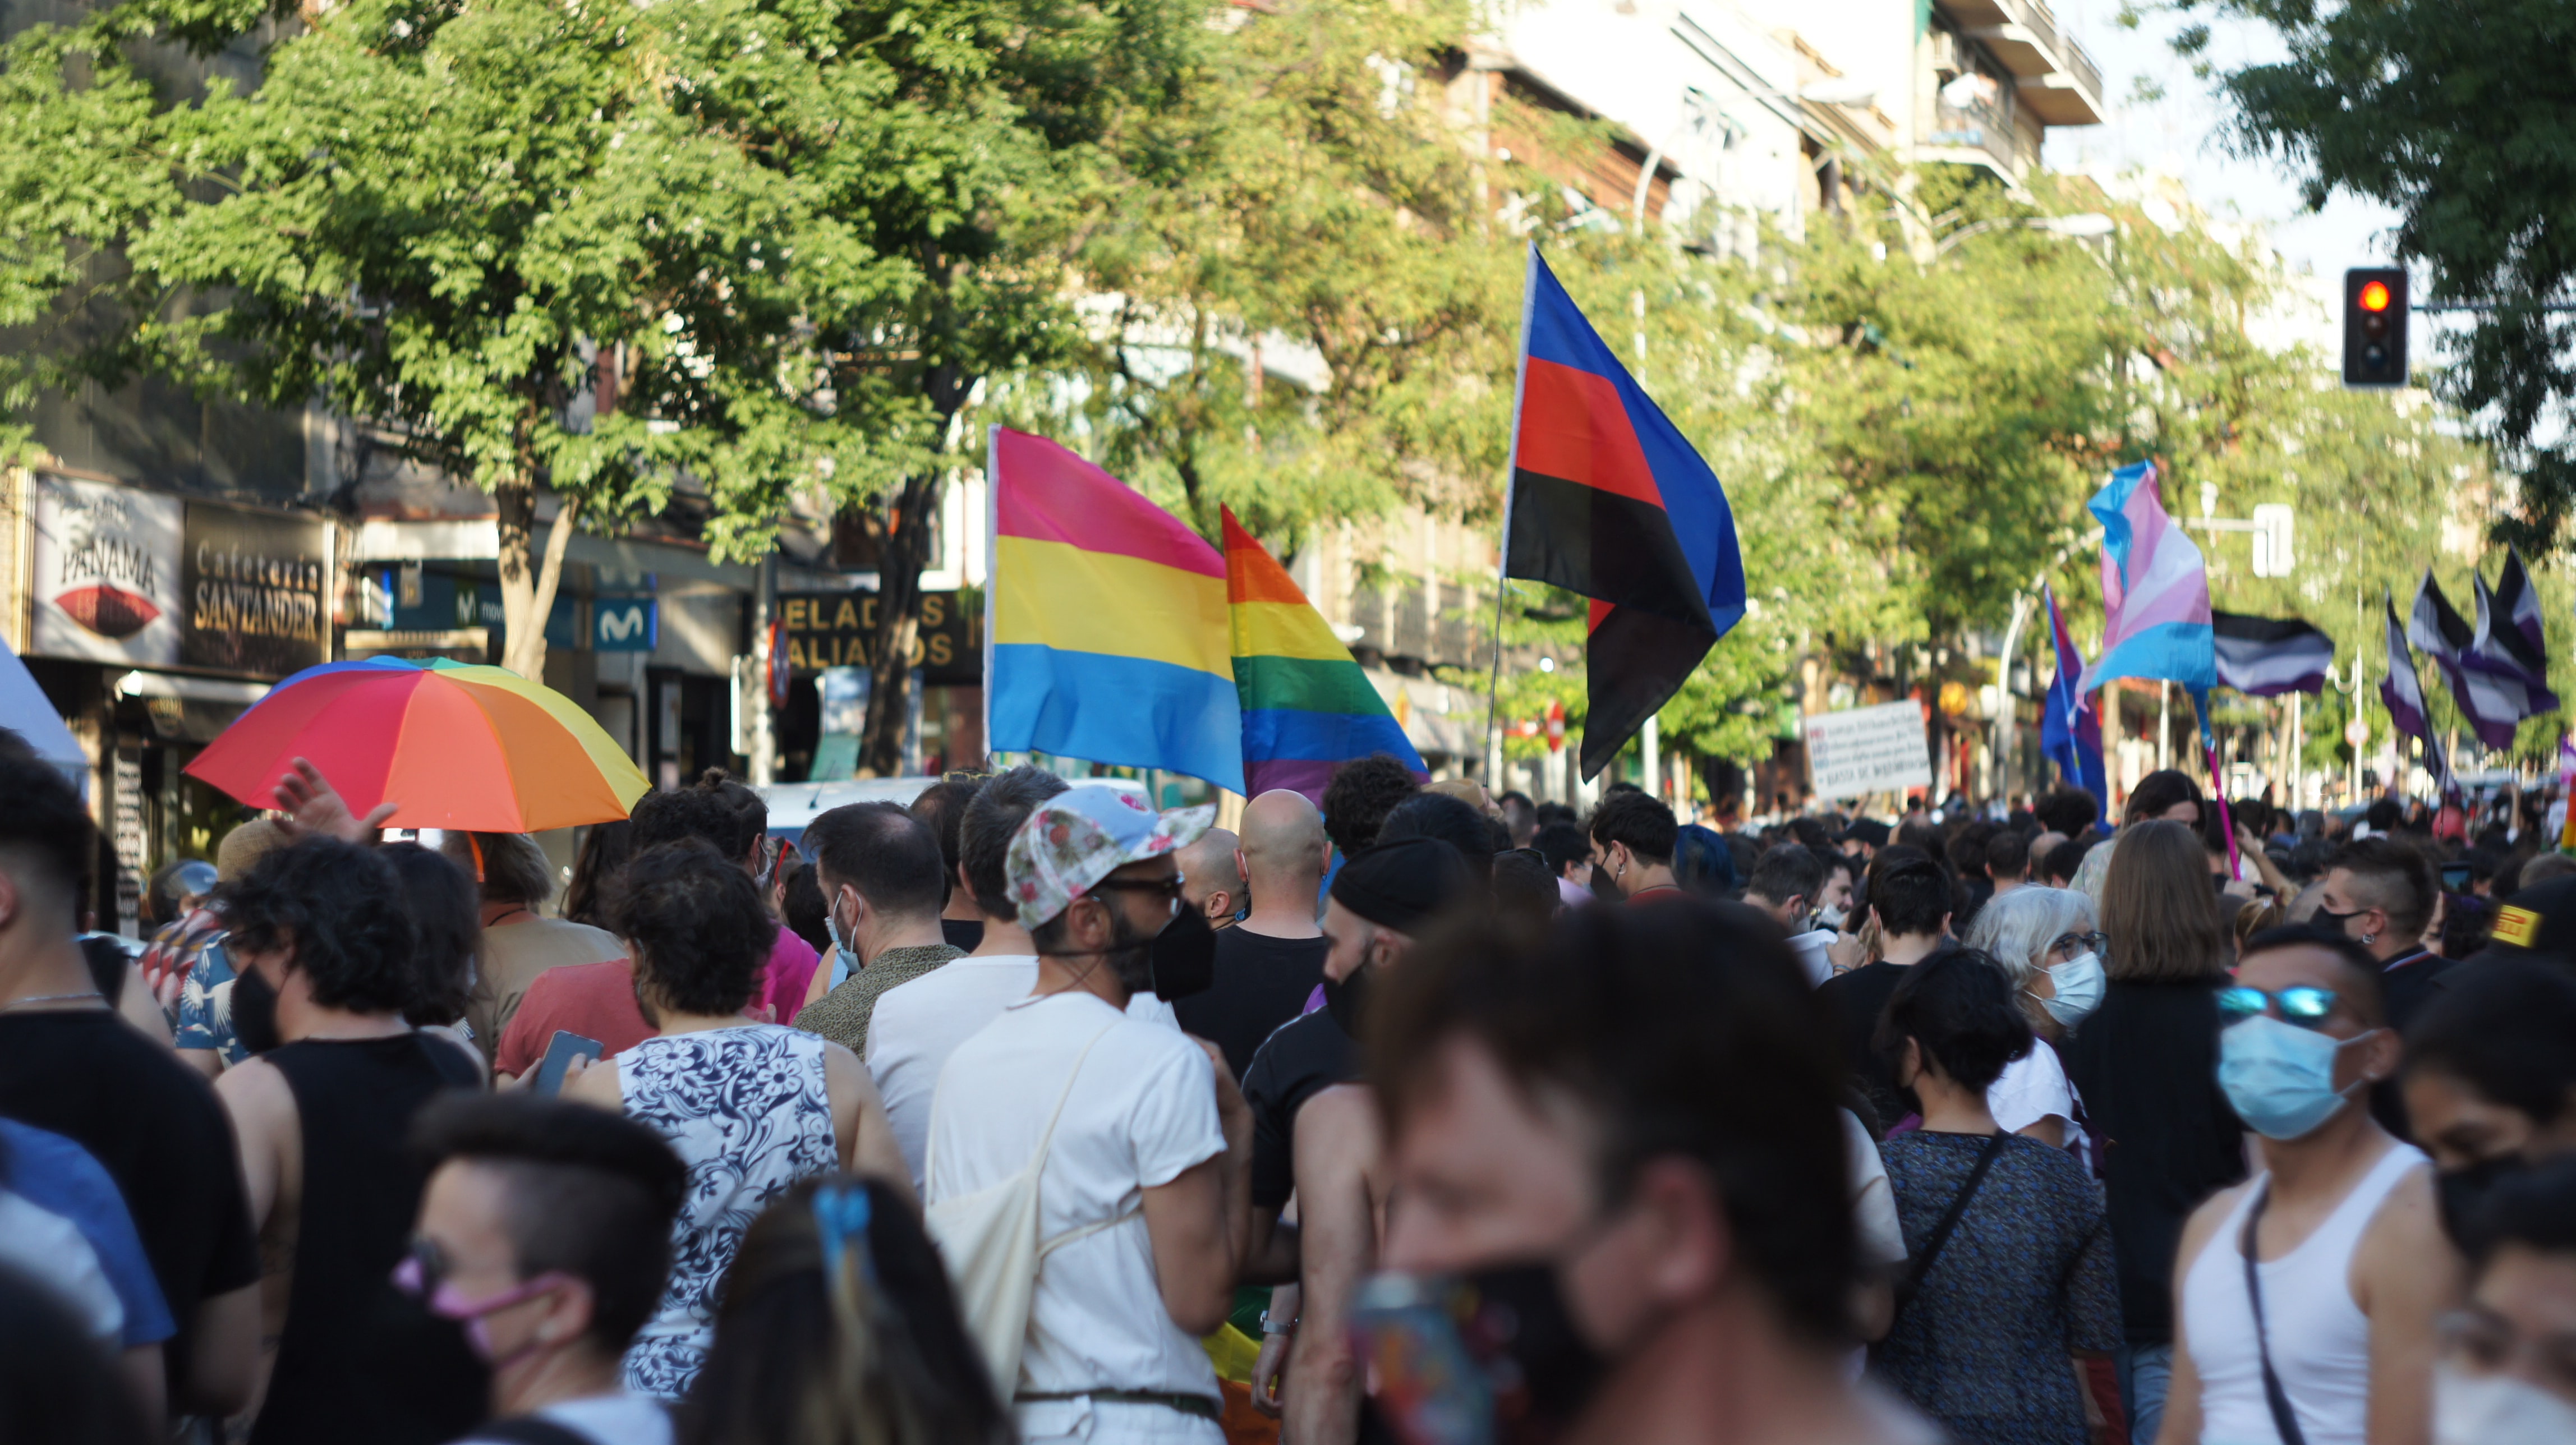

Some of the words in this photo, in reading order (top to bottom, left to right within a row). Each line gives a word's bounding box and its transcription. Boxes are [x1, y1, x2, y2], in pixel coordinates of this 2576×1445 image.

[61, 537, 156, 597] PANAMA
[194, 579, 318, 642] SANTANDER
[776, 594, 945, 630] ELADS
